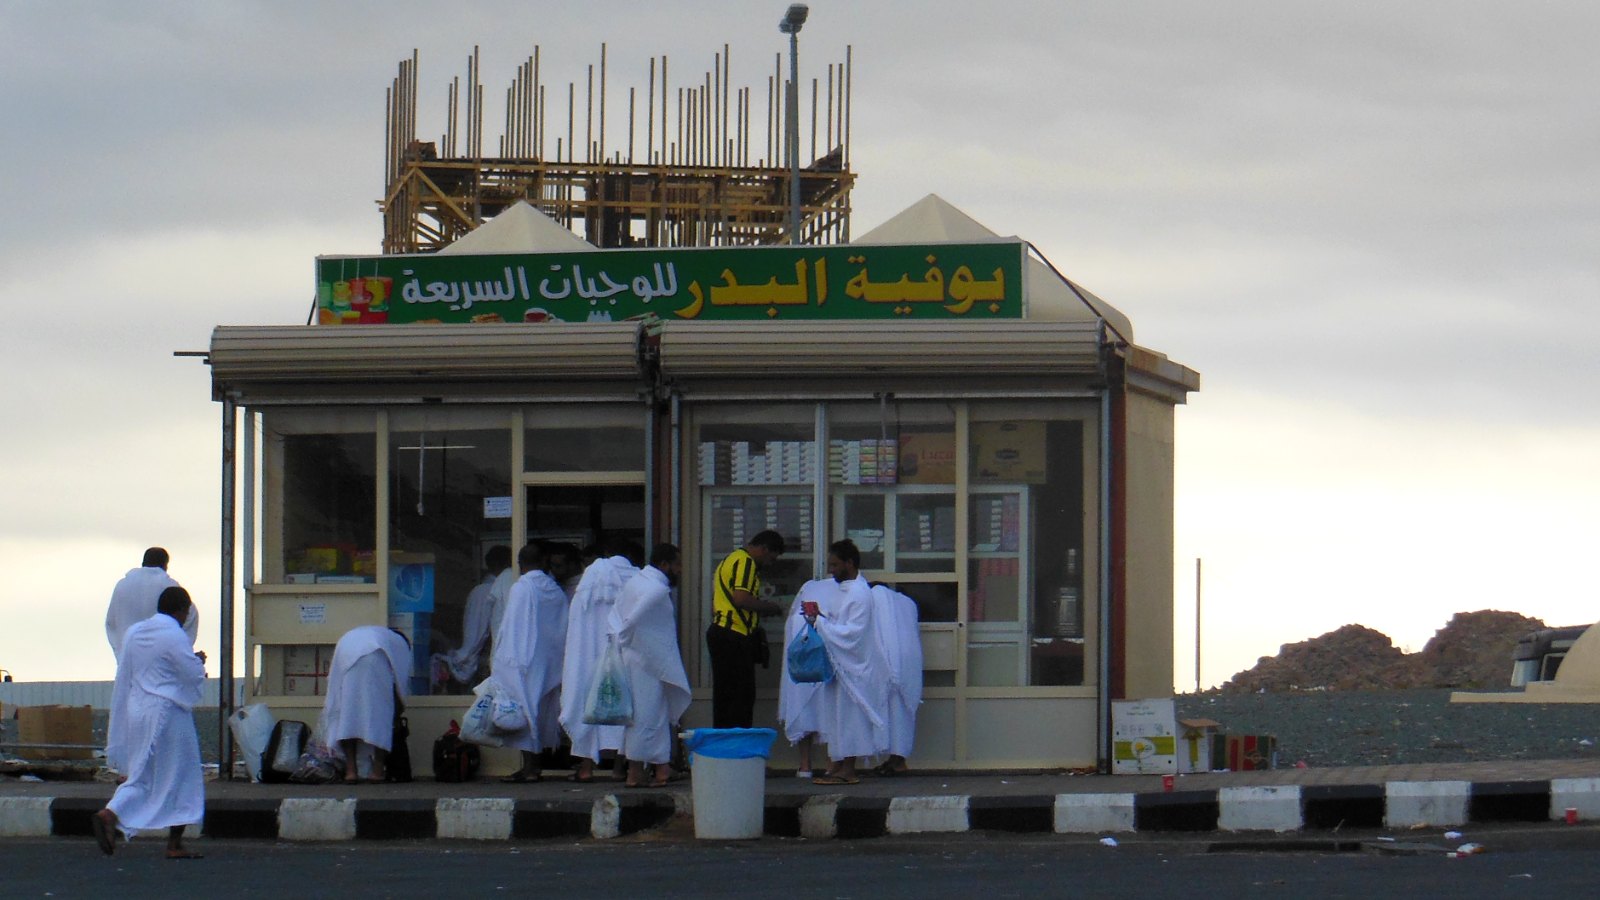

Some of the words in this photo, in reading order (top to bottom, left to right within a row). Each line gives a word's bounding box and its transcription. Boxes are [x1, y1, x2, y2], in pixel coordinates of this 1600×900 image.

[401, 265, 531, 312] السريعة
[538, 261, 678, 306] للوجبات
[673, 256, 828, 320] البدر
[845, 253, 1006, 315] بوفية
